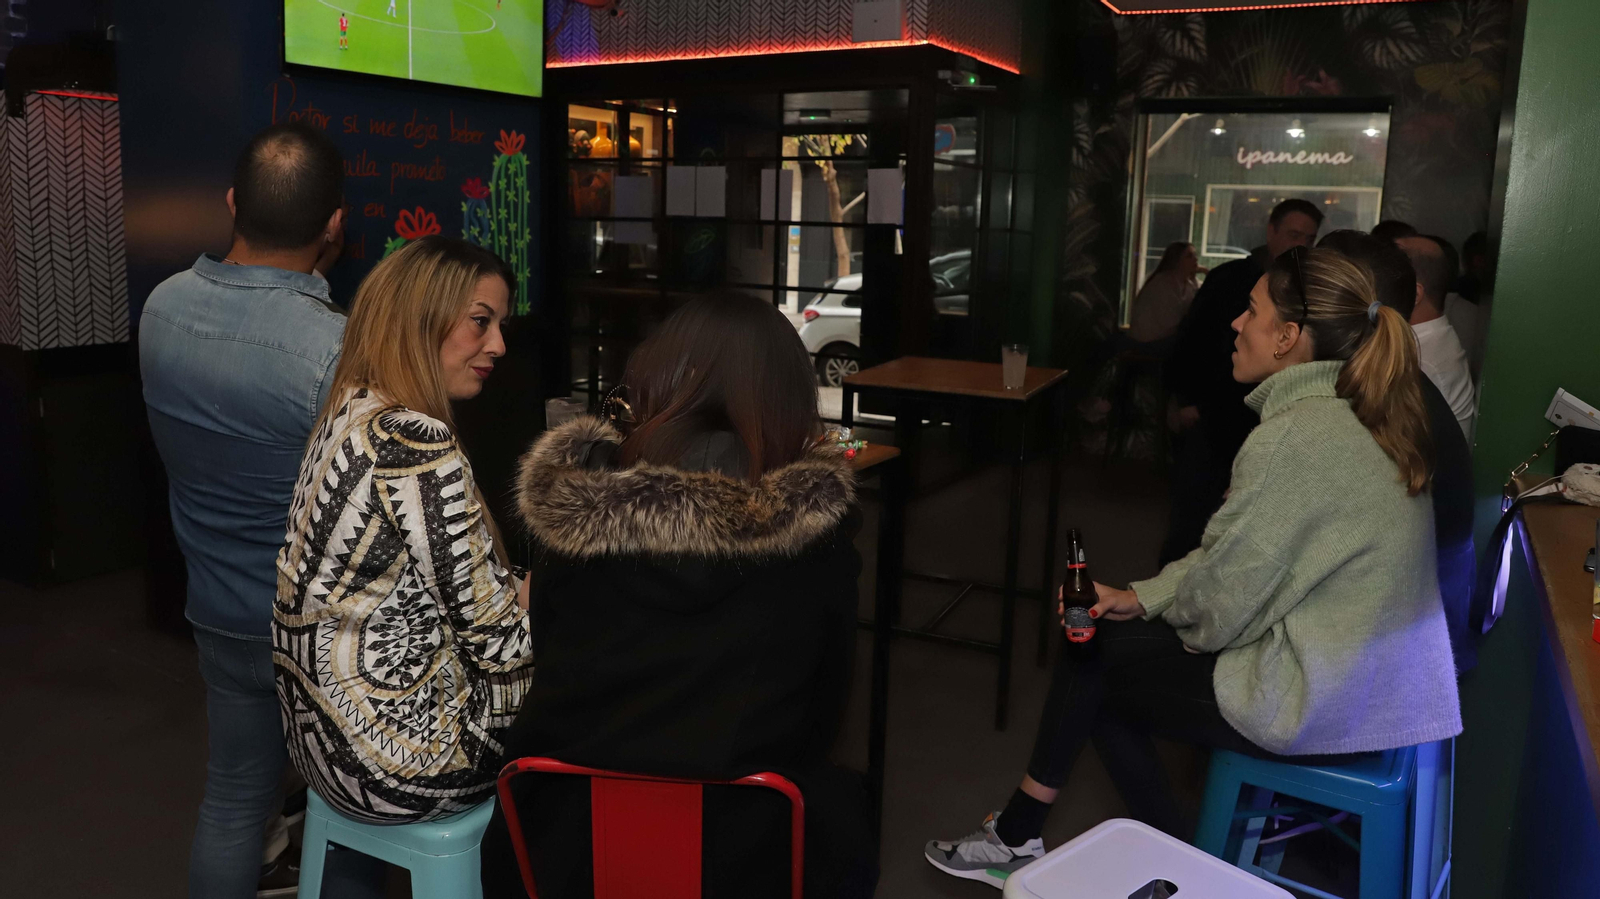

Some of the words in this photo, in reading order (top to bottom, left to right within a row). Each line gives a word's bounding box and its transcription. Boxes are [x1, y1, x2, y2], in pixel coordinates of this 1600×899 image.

[342, 113, 361, 134] si
[370, 118, 397, 137] me
[403, 108, 439, 149] deja
[449, 108, 487, 144] beber
[342, 148, 382, 177] uila
[389, 154, 447, 196] prometo
[1236, 146, 1354, 170] ipanema
[363, 202, 387, 219] en
